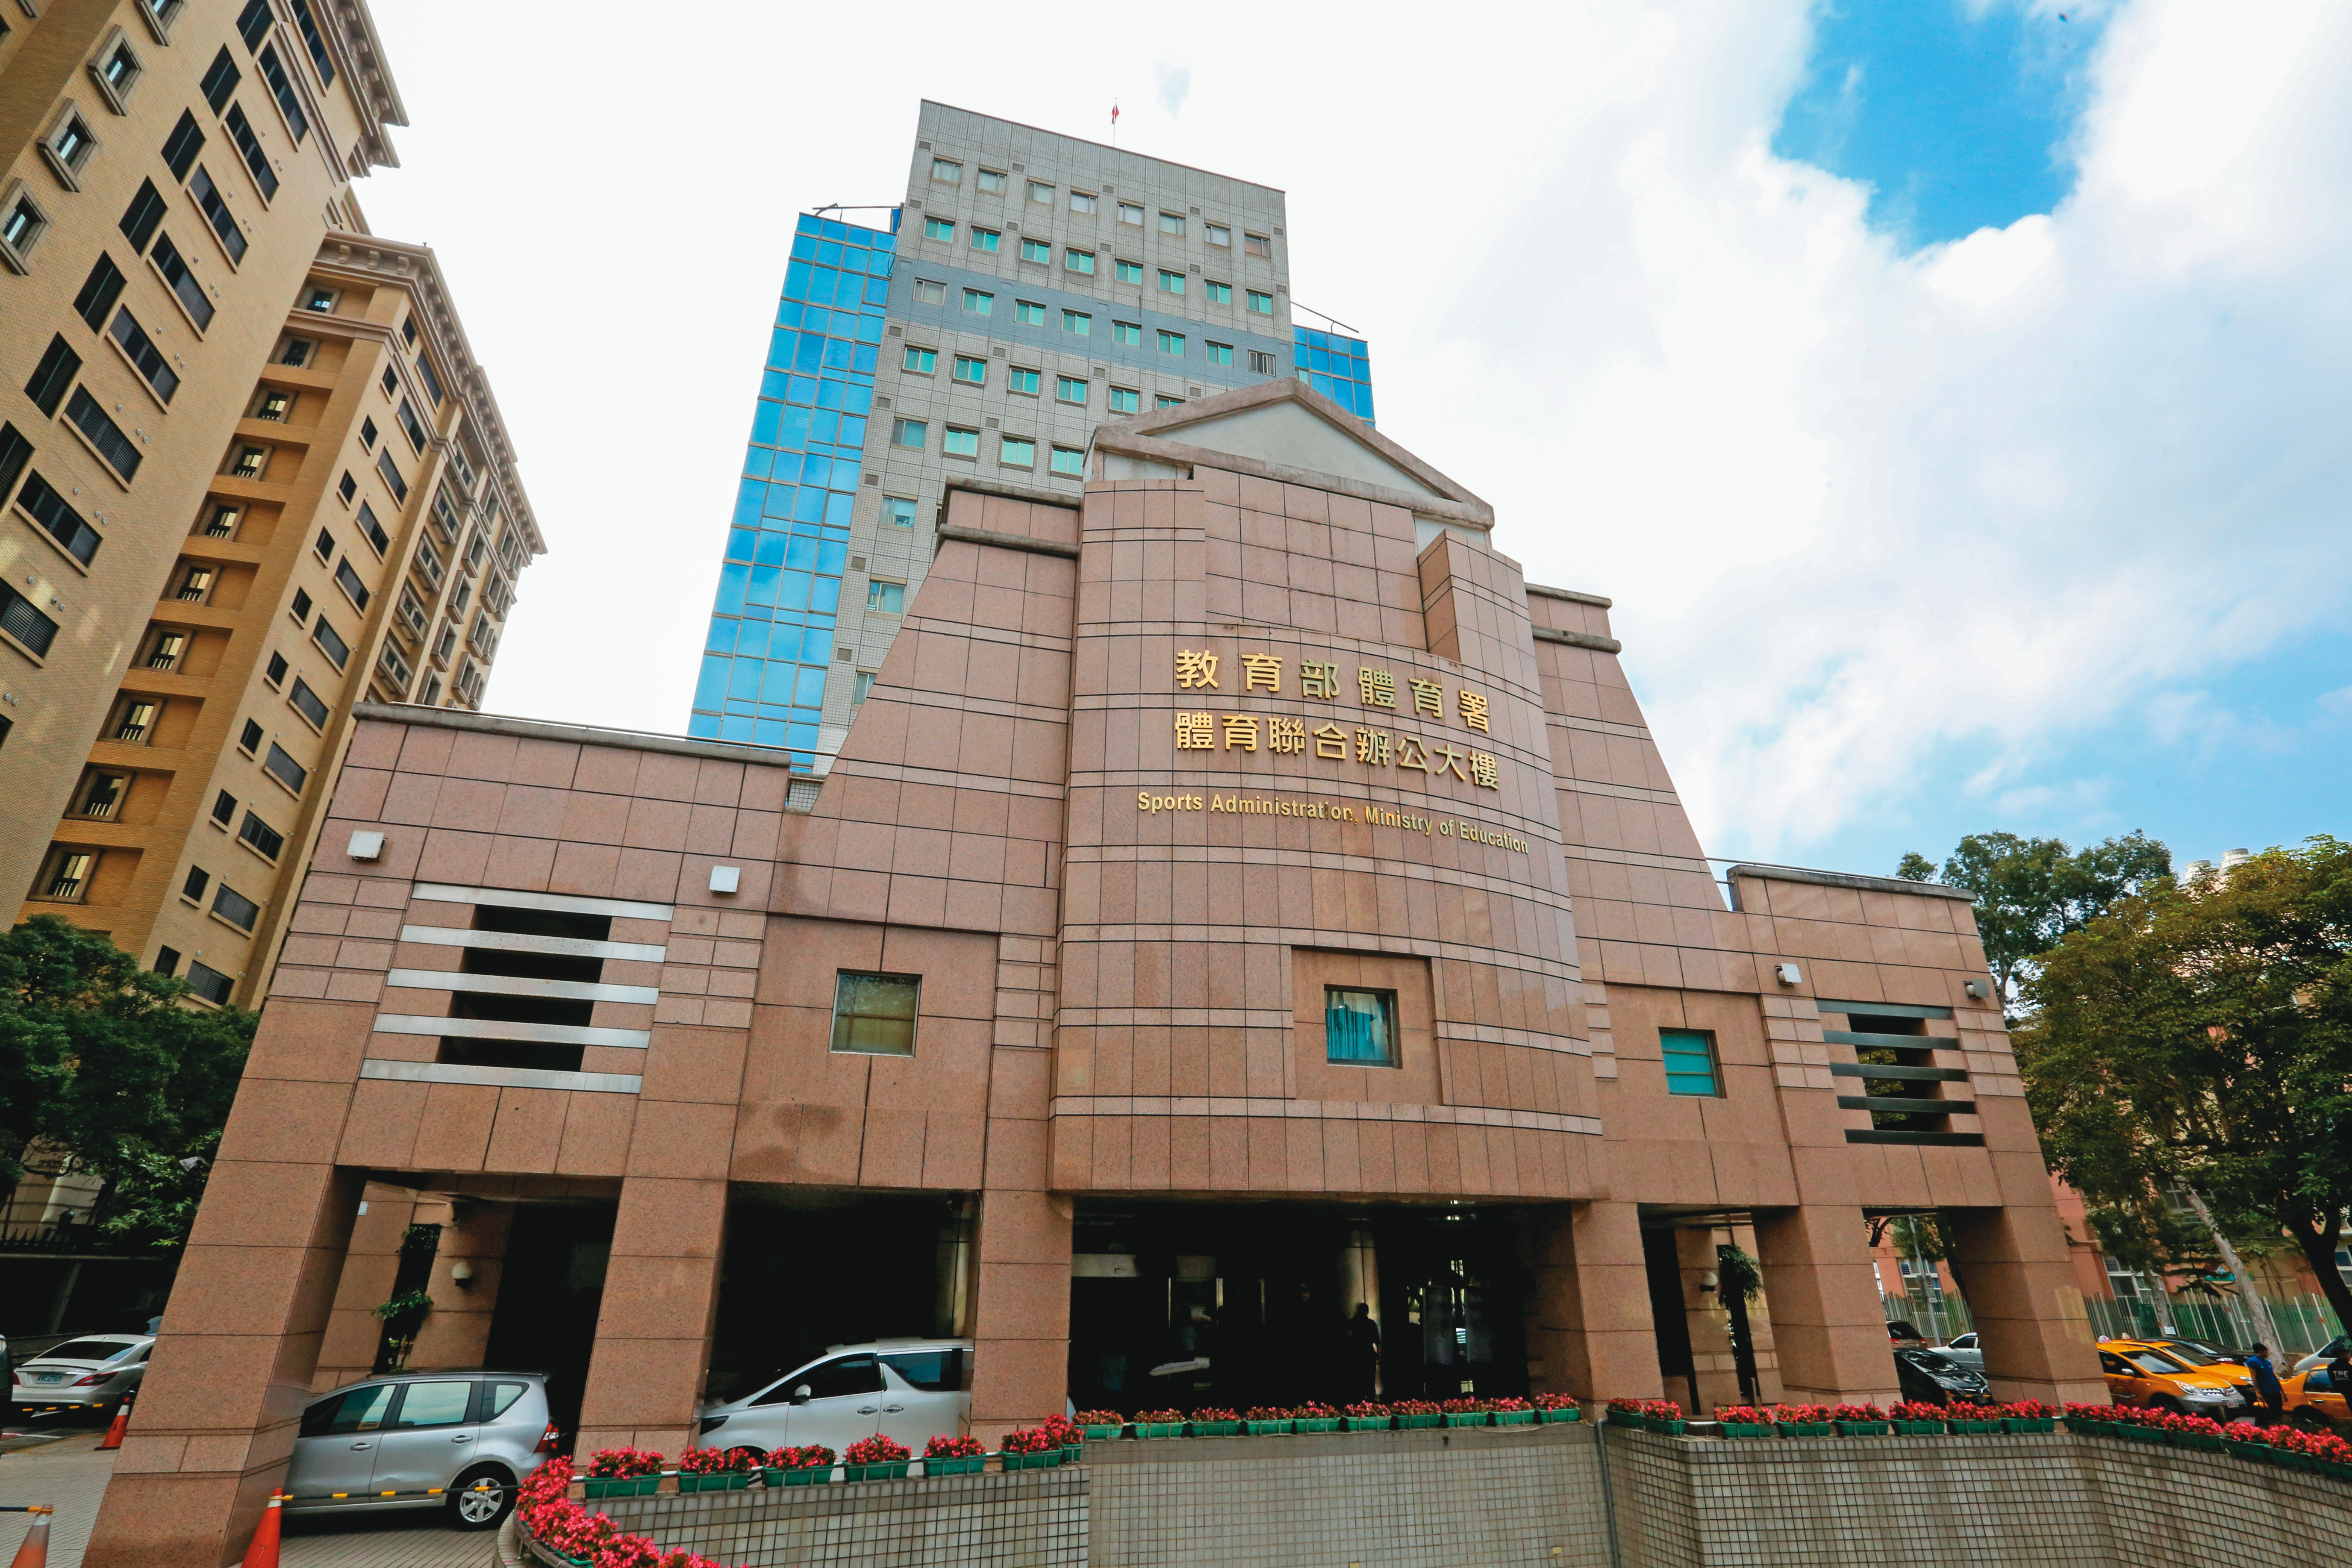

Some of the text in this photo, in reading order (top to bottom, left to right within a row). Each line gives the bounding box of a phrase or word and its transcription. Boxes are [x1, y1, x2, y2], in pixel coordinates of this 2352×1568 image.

[1176, 649, 1490, 733] 教育部體育署
[1175, 712, 1499, 791] 體育聯合辦公大樓
[1138, 791, 1528, 854] Sports Administration, Ministry of Education
